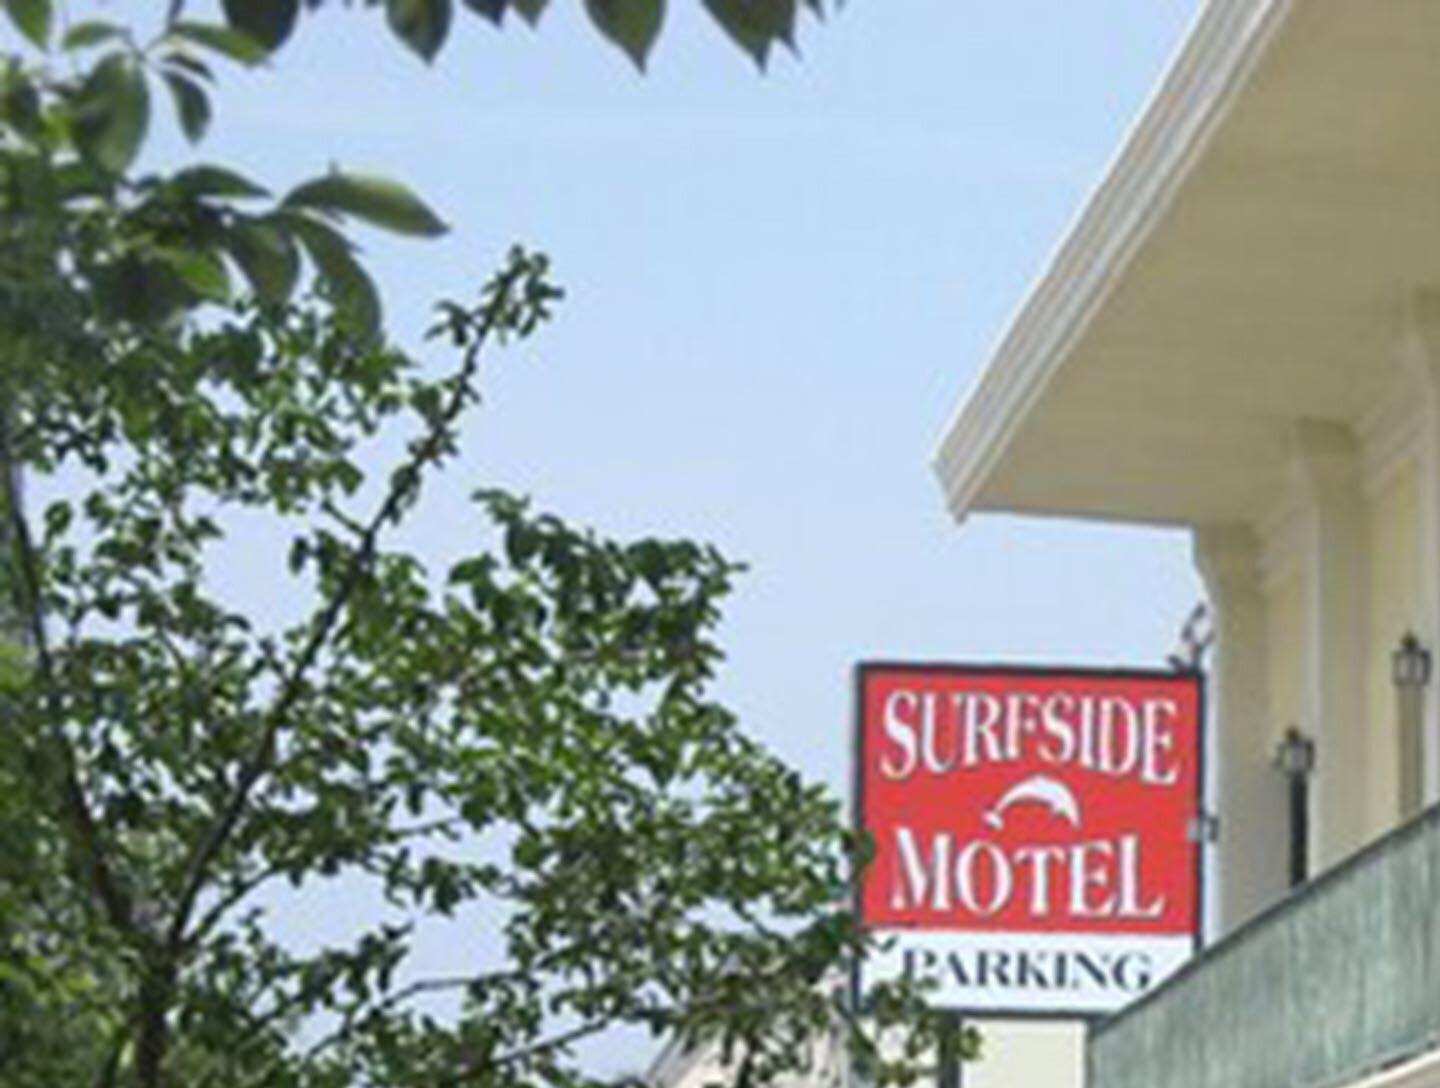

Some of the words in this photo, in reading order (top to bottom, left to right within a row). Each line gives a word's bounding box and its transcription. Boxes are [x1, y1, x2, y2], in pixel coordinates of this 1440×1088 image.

[881, 690, 1179, 784] SURFSIDE
[891, 826, 1165, 918] MOTEL
[903, 948, 1152, 991] PARKING
